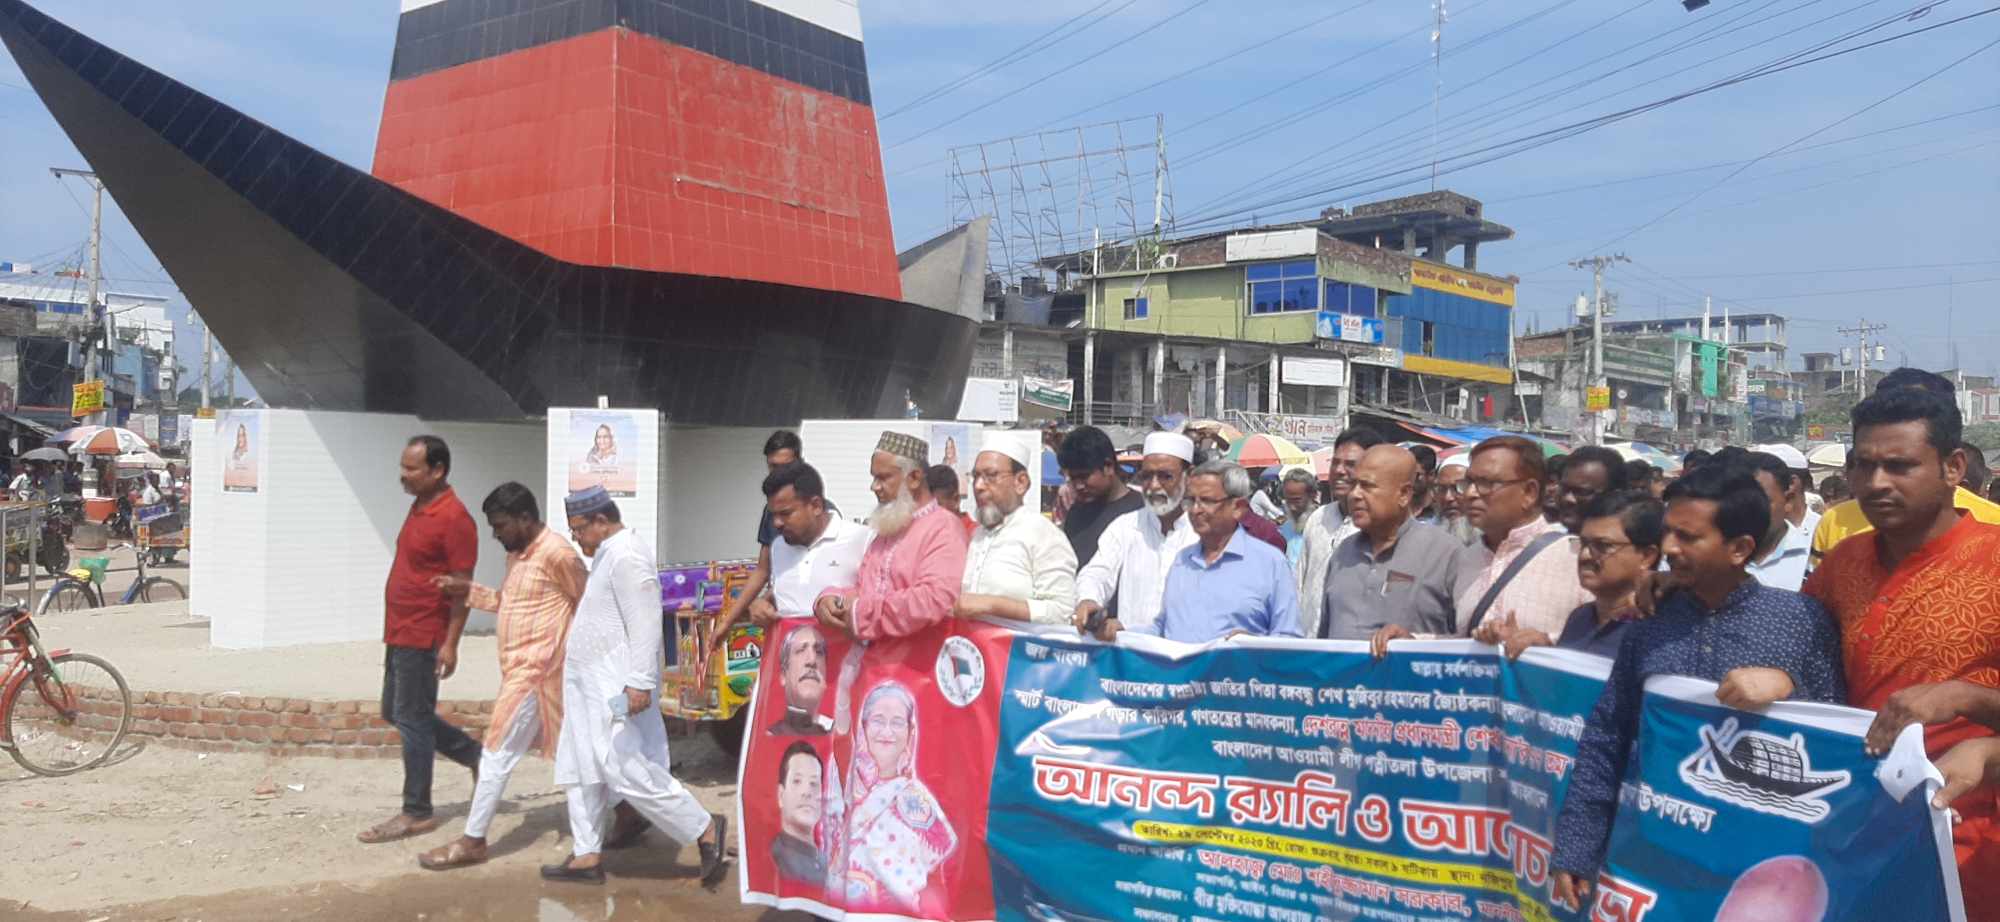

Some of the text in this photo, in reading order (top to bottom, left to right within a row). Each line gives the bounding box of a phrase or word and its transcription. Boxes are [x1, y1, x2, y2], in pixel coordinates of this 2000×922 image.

[1053, 649, 1088, 668] বাংলা
[1100, 677, 1164, 697] বাংলাদেশের
[1209, 678, 1246, 698] জাতির
[1249, 678, 1276, 700] পিতা
[1318, 686, 1344, 703] শেখ
[1212, 740, 1273, 757] বাংলাদেশ
[1276, 746, 1335, 767] আওয়ামী
[1338, 748, 1362, 769] লীগ
[1420, 757, 1494, 783] উপজেলা
[1032, 756, 1220, 815] আনন্দ
[1225, 769, 1352, 838] র‍্যালি
[1354, 795, 1393, 842] ও
